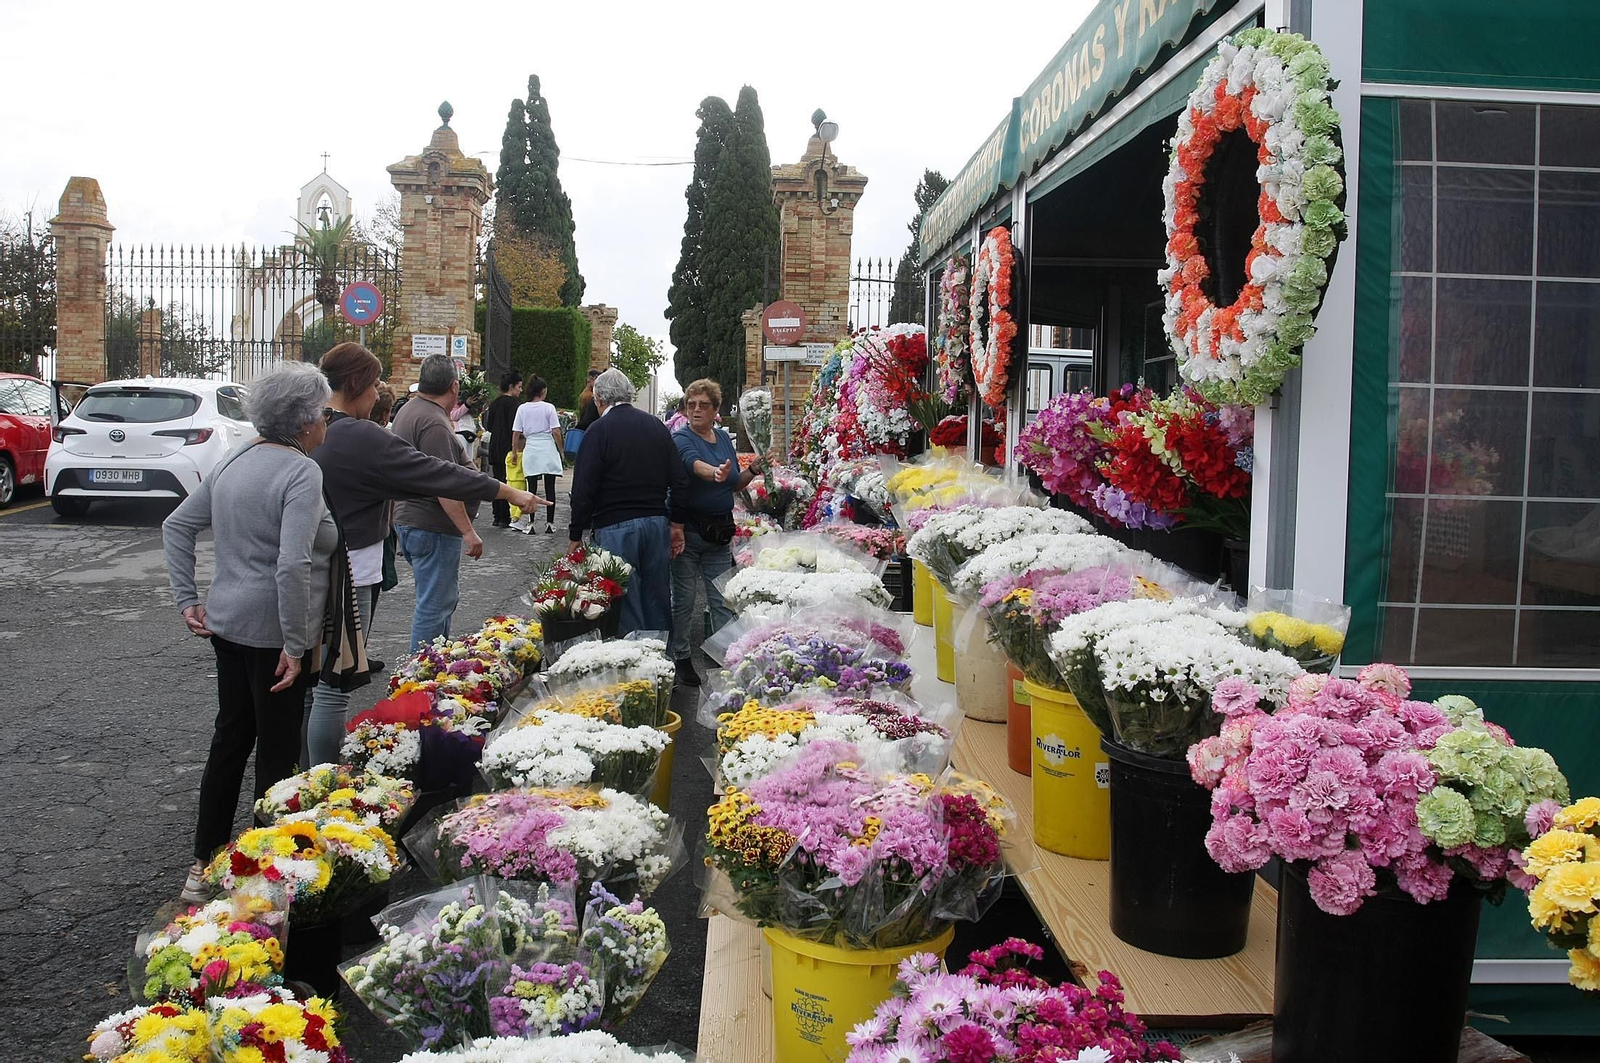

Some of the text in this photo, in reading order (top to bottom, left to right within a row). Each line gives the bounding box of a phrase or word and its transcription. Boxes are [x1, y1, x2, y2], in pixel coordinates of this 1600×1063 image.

[1020, 24, 1106, 153] CORONAS
[1114, 0, 1130, 59] Y
[95, 470, 140, 480] 0930 MHB
